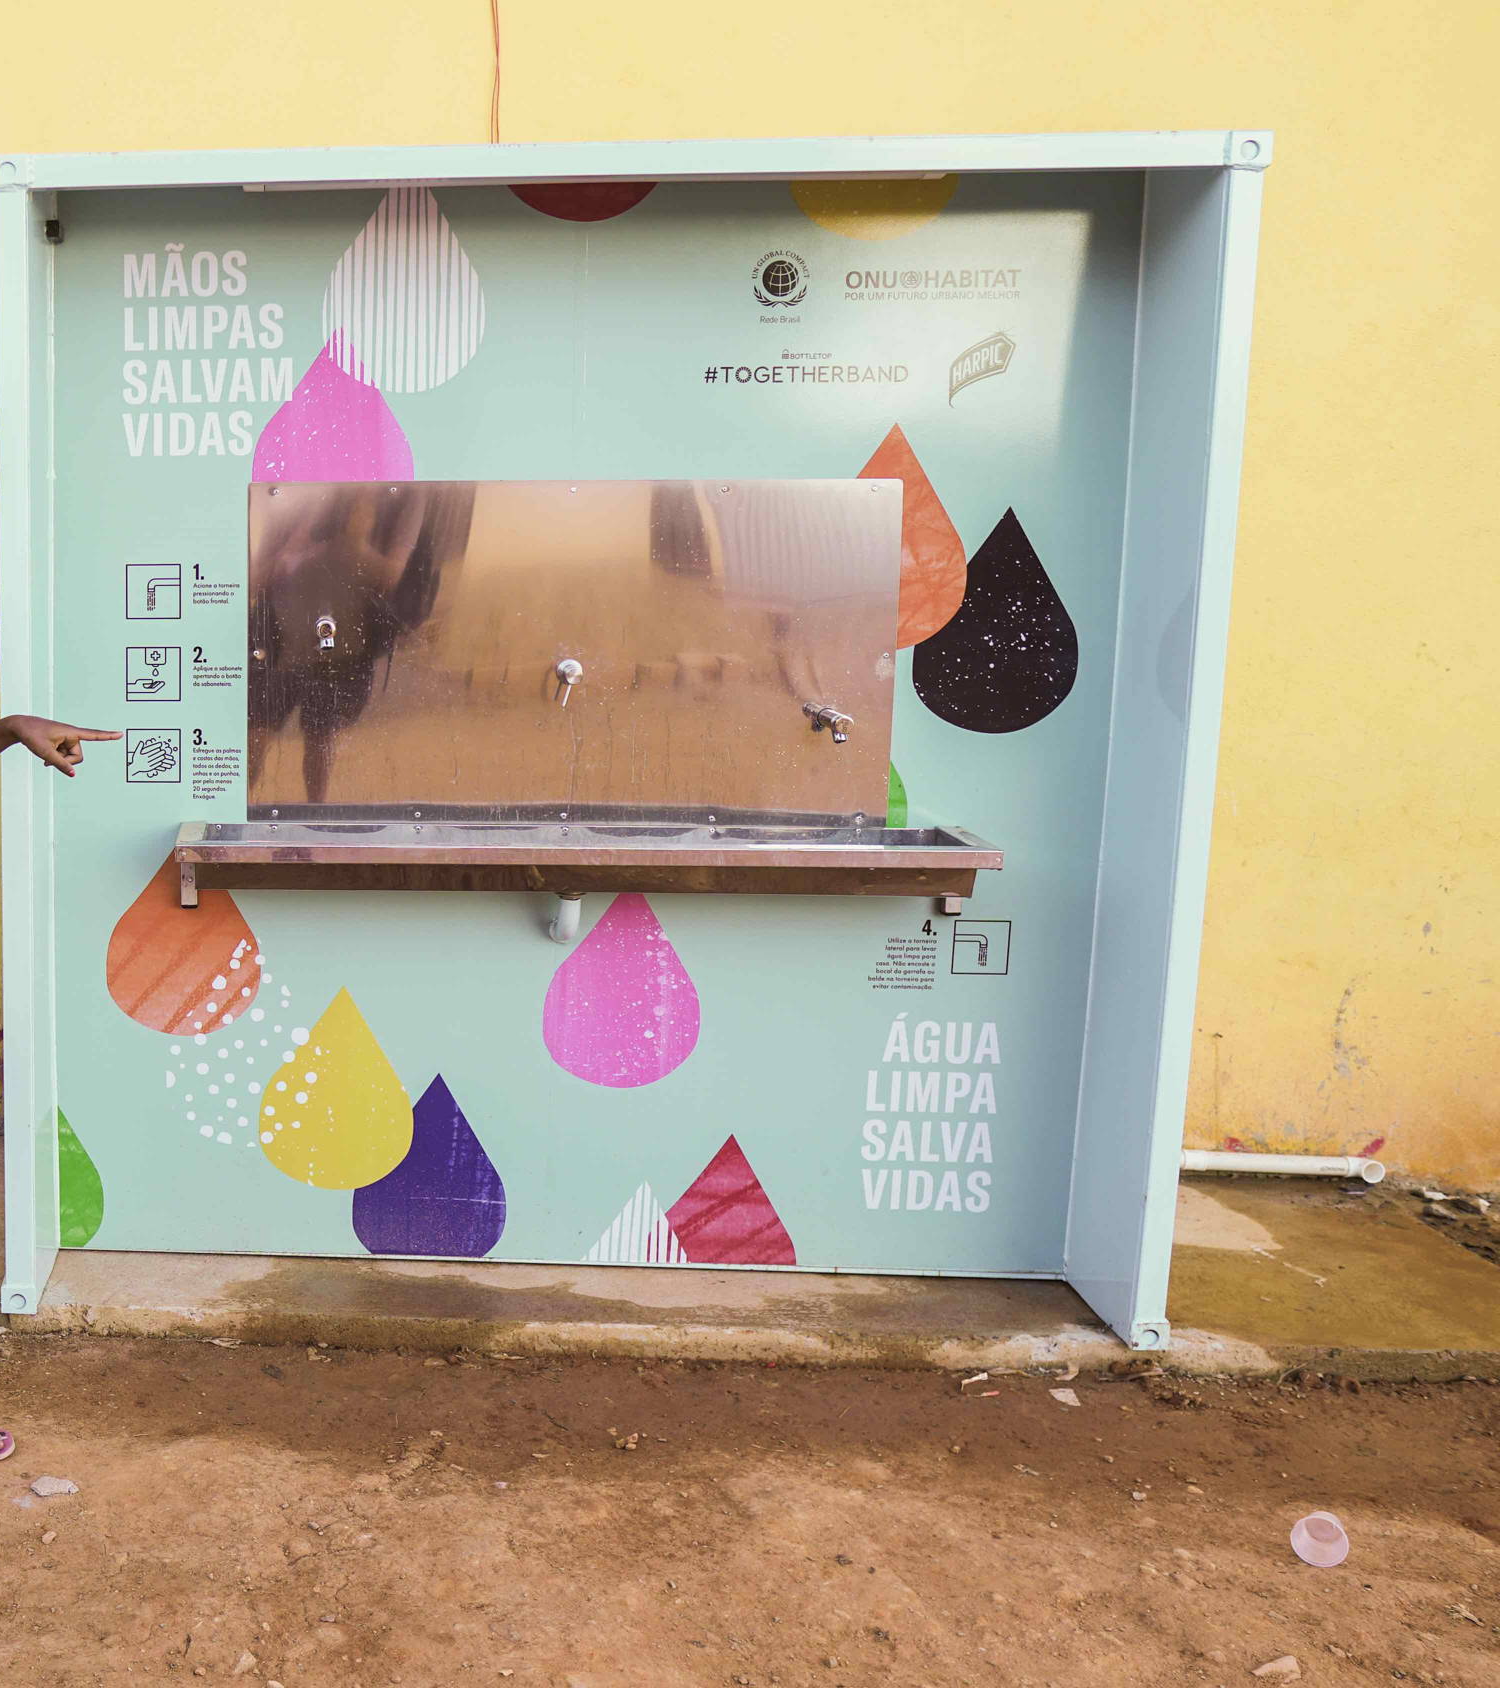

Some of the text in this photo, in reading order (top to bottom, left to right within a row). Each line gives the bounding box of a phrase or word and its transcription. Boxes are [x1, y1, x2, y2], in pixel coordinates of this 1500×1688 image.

[123, 242, 248, 298] MÃOS
[752, 250, 810, 279] UN GLOBAL COMPACT
[845, 269, 1022, 289] ONU HABITAT
[844, 290, 1021, 301] POR UM FUTURO URBANO MELHOR
[123, 303, 285, 352] LIMPAS
[760, 315, 801, 324] Rede Brasil
[122, 357, 294, 405] SALVAM
[704, 366, 909, 384] #TOGETHERBAND
[953, 342, 1004, 388] HARPIC
[122, 410, 254, 457] VIDAS
[193, 563, 205, 580] 1.
[193, 646, 207, 663] 2.
[193, 729, 207, 746] 3.
[922, 919, 937, 936] 4.
[882, 1012, 1001, 1065] ÁGUA
[865, 1070, 997, 1114] LIMPA
[860, 1119, 993, 1163] SALVA
[861, 1169, 992, 1213] VIDAS
